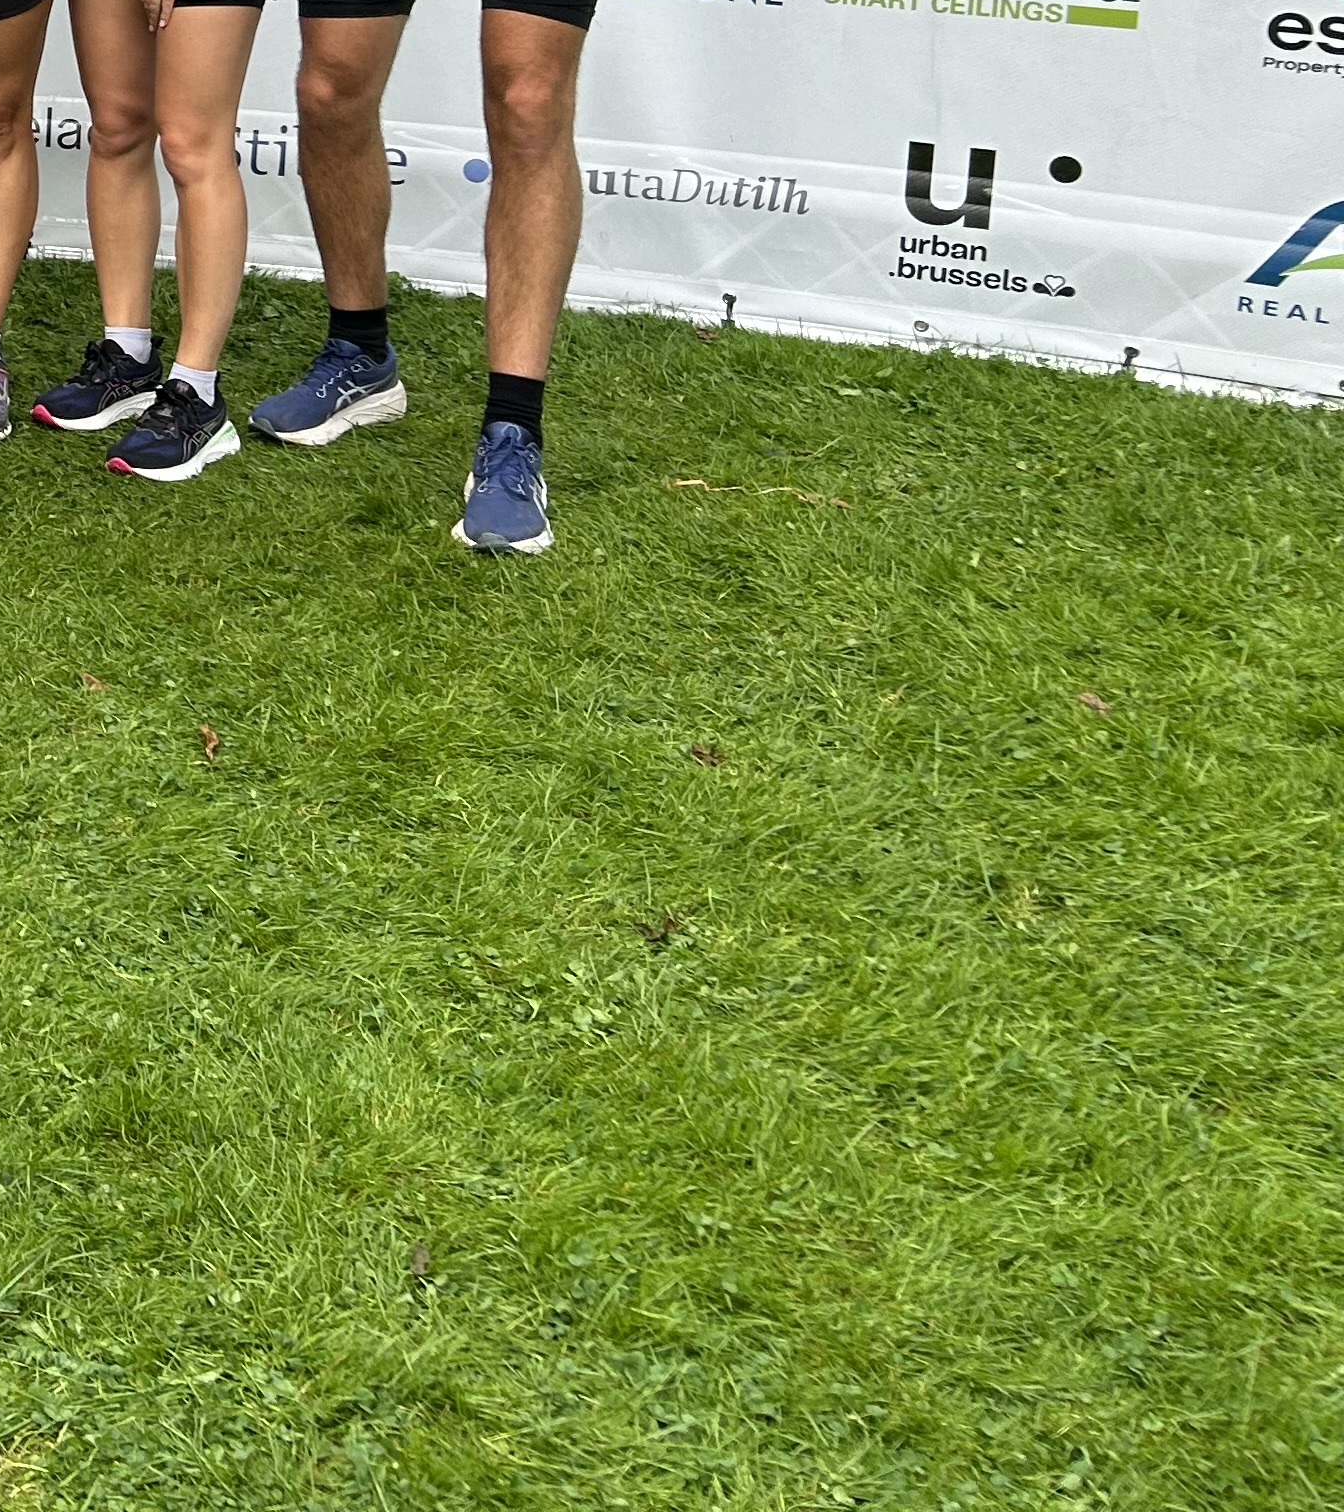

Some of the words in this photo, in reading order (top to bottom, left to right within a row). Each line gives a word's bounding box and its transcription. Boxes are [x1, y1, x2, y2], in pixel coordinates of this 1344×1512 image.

[899, 234, 988, 262] urban
[888, 258, 1028, 293] .brussels
[1237, 295, 1330, 325] REAL
